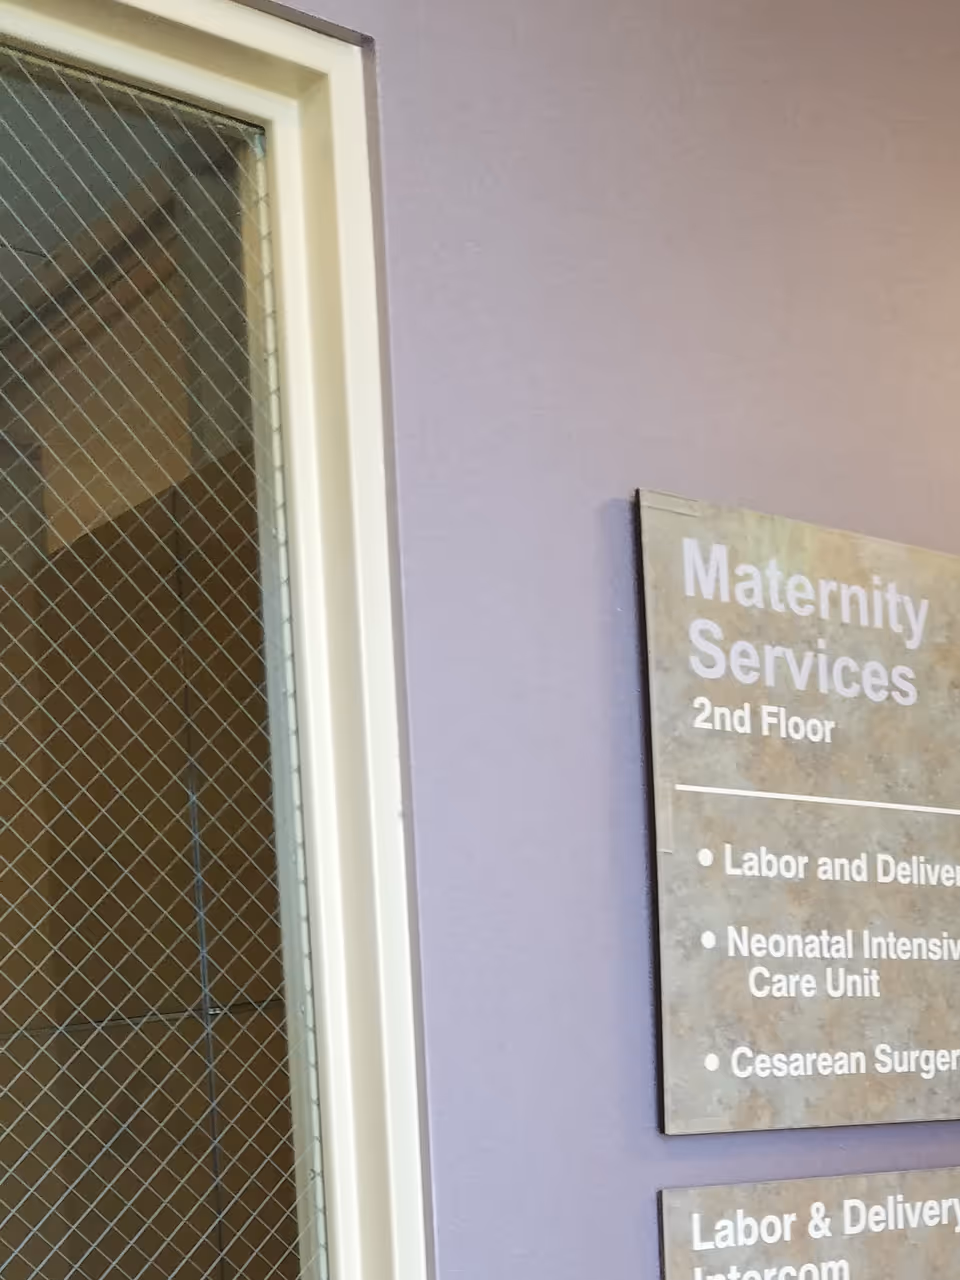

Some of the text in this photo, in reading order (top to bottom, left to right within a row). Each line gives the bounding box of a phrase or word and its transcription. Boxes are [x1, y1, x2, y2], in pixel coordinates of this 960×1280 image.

[682, 538, 929, 650] Maternity
[688, 619, 918, 706] Services
[693, 697, 836, 743] 2nd Floor
[725, 844, 808, 880] Labor
[817, 850, 868, 883] and
[727, 926, 853, 960] Neonatal
[748, 966, 881, 999] Care Unit
[731, 1045, 866, 1079] Cesarean
[692, 1208, 797, 1251] Labor
[808, 1201, 832, 1239] &
